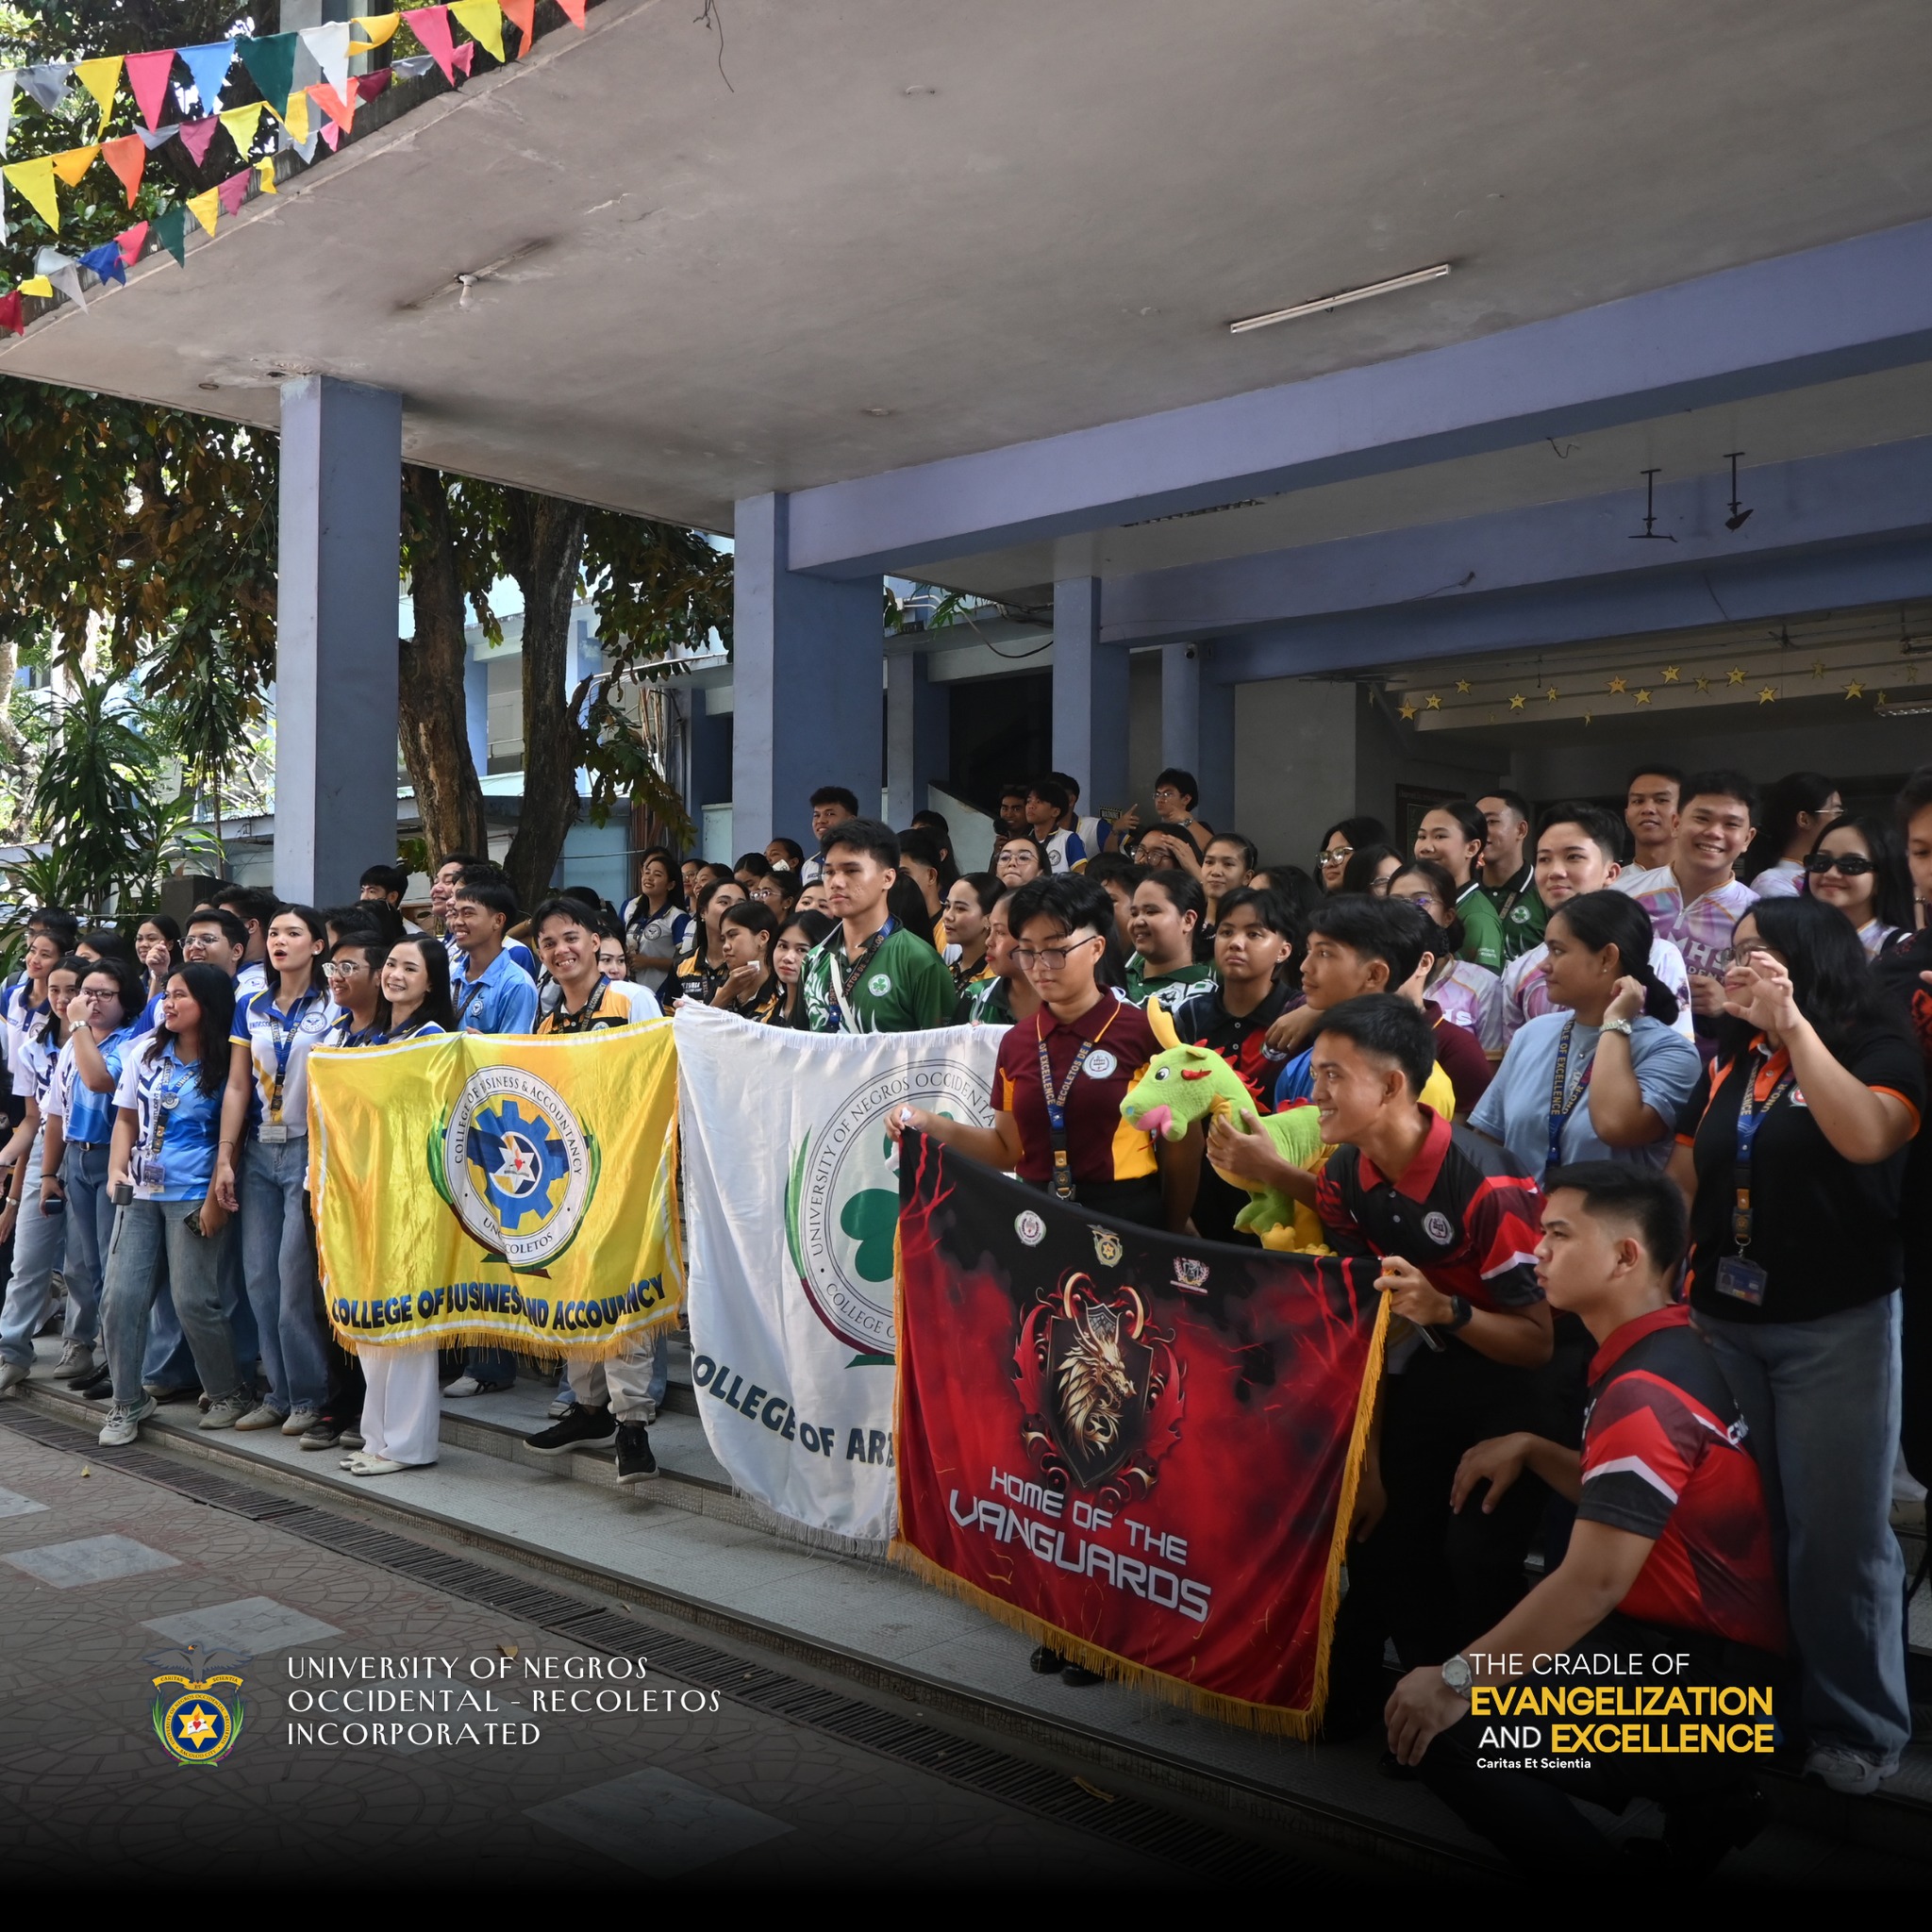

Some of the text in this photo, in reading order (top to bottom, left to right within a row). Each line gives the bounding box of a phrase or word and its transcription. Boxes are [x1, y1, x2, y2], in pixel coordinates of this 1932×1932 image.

[1039, 1042, 1056, 1106] OF EXCELLENCE
[1056, 1059, 1082, 1107] RECOLETOS
[1077, 1048, 1089, 1059] DE
[1559, 1043, 1568, 1054] OF
[1551, 1057, 1566, 1115] EXCELLENCE
[1561, 1085, 1584, 1115] UNO-R
[1760, 1083, 1788, 1113] UNO-R
[455, 1104, 470, 1164] COLLEGE
[467, 1086, 479, 1104] OF
[522, 1080, 529, 1093] &
[530, 1086, 582, 1176] ACCOUNTANCY
[809, 1072, 996, 1257] UNIVERSITY OF NEGROS OCCIDENTA
[417, 1287, 445, 1320] OF
[826, 1283, 884, 1334] COLLEGE
[691, 1346, 796, 1441] OLLEGE
[800, 1422, 835, 1457] OF
[991, 1466, 1188, 1566] HOME OF THE
[949, 1489, 1211, 1623] VANGUARDS
